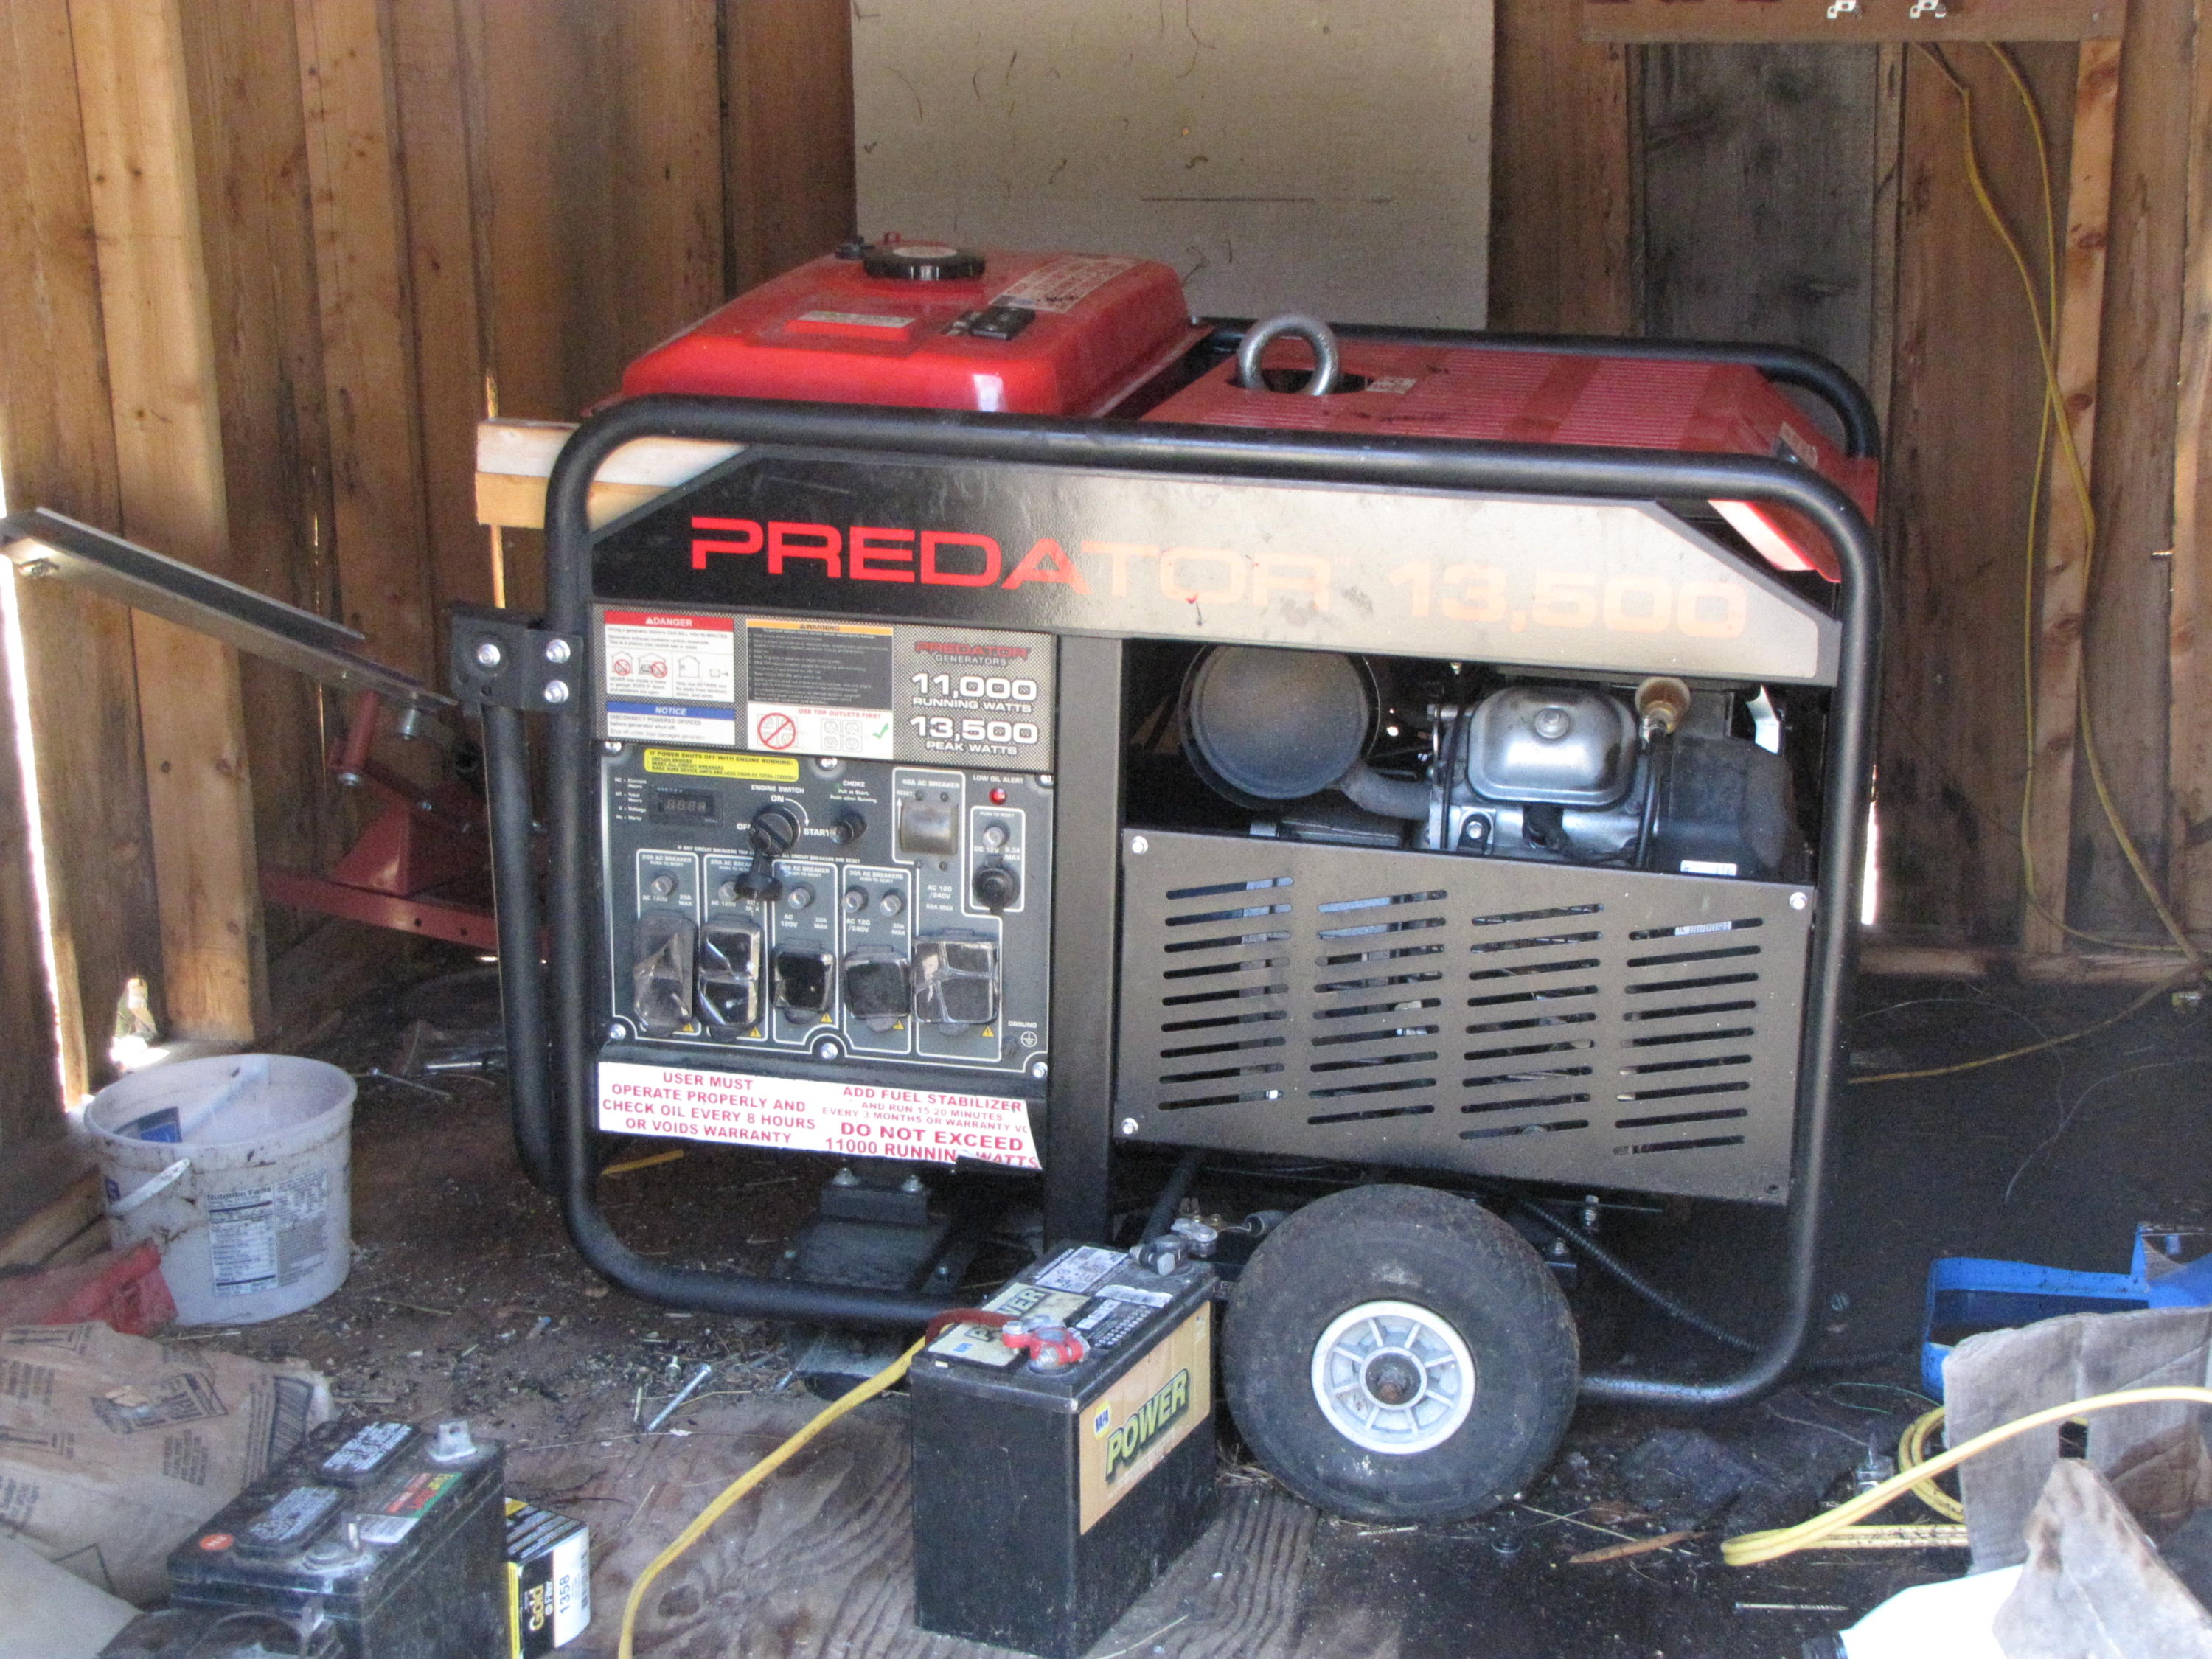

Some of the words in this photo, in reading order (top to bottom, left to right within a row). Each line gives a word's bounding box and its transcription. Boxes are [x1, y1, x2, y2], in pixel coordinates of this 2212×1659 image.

[691, 516, 1328, 611] PREDATOR
[1390, 560, 1746, 639] 13,500
[653, 618, 693, 627] DANGER
[915, 641, 1029, 658] PREDATOR
[936, 655, 1007, 665] GENERATORS
[911, 672, 1037, 700] 11,000
[655, 706, 687, 715] NOTICE
[829, 710, 860, 718] OUTLETS
[913, 697, 978, 709] RUNNING
[983, 702, 1032, 712] WATTS
[910, 717, 1038, 743] 13,500
[926, 741, 964, 751] PEAK
[969, 744, 1018, 755] WATTS
[928, 780, 960, 788] BREAKER
[804, 828, 830, 836] START
[872, 872, 903, 880] BREAKERS
[664, 1072, 703, 1085] USER
[709, 1076, 754, 1090] MUST
[612, 1084, 681, 1100] OPERATE
[687, 1091, 767, 1109] PROPERLY
[773, 1100, 805, 1112] AND
[844, 1087, 874, 1098] ADD
[882, 1090, 922, 1102] FUEL
[928, 1094, 1022, 1112] STABILIZER
[603, 1099, 655, 1113] CHECK
[661, 1105, 686, 1117] OIL
[692, 1107, 740, 1122] EVERY
[747, 1113, 755, 1124] 8
[761, 1115, 815, 1130] HOURS
[823, 1107, 858, 1116] EVERY
[863, 1110, 869, 1119] 3
[874, 1111, 922, 1122] MONTHS
[926, 1116, 942, 1124] OR
[946, 1118, 1010, 1130] WARRANTY
[861, 1102, 885, 1110] AND
[889, 1104, 913, 1113] RUN
[934, 1107, 947, 1116] 20
[951, 1109, 1003, 1121] MINUTES
[626, 1118, 646, 1130] OR
[653, 1121, 698, 1135] VOIDS
[703, 1126, 792, 1143] WARRANTY
[841, 1122, 872, 1137] DO
[880, 1126, 925, 1141] NOT
[934, 1131, 1023, 1151] EXCEED
[826, 1138, 877, 1154] 11000
[885, 1143, 957, 1162] RUNNIN
[1095, 1408, 1109, 1433] NAPA
[1107, 1369, 1189, 1478] POWER
[560, 1575, 570, 1614] 1358
[529, 1584, 544, 1631] Gold
